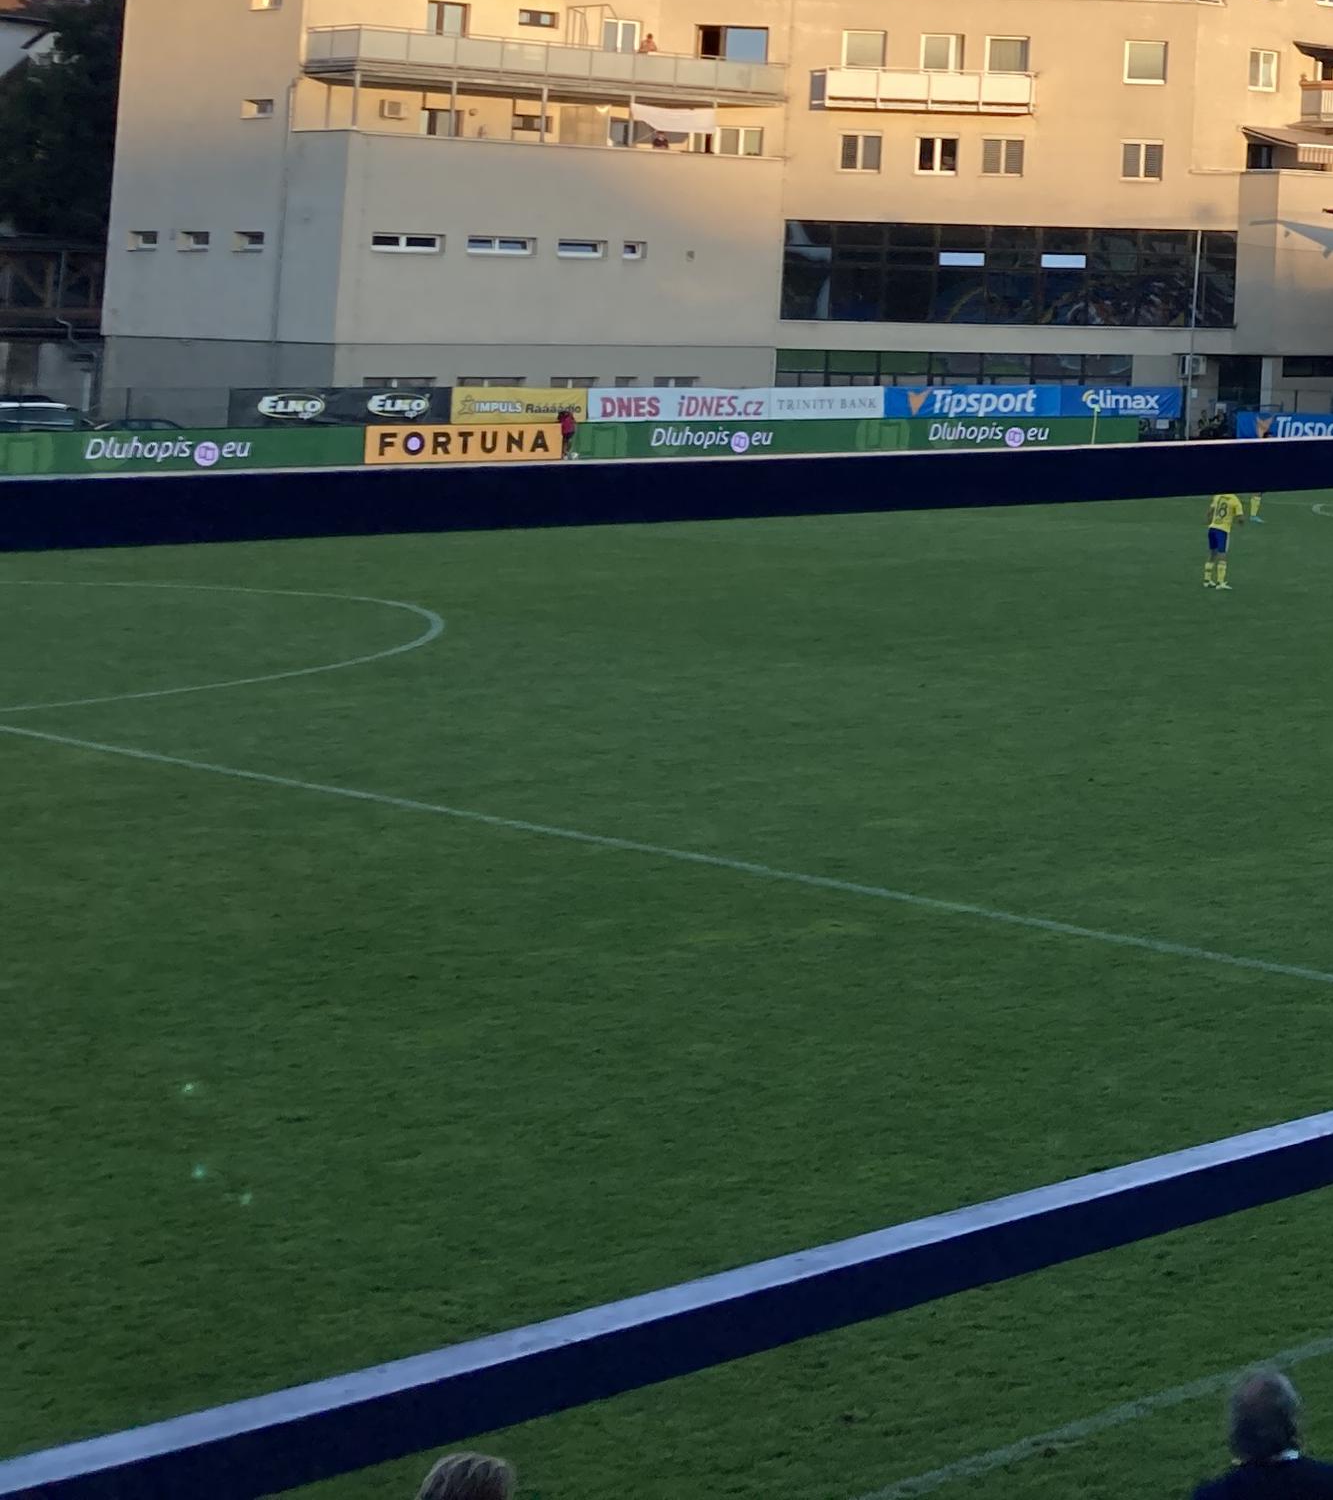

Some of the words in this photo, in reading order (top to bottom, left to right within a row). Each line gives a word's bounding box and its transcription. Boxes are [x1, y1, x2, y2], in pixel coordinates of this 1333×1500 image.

[475, 401, 522, 413] IMPULS
[601, 396, 660, 418] DNES
[677, 395, 763, 417] iDNES.cz
[778, 398, 834, 410] TRINITY
[840, 397, 877, 409] BANK
[932, 389, 1037, 418] Tipsport
[1084, 389, 1160, 409] climax
[378, 430, 550, 456] FORTUNA
